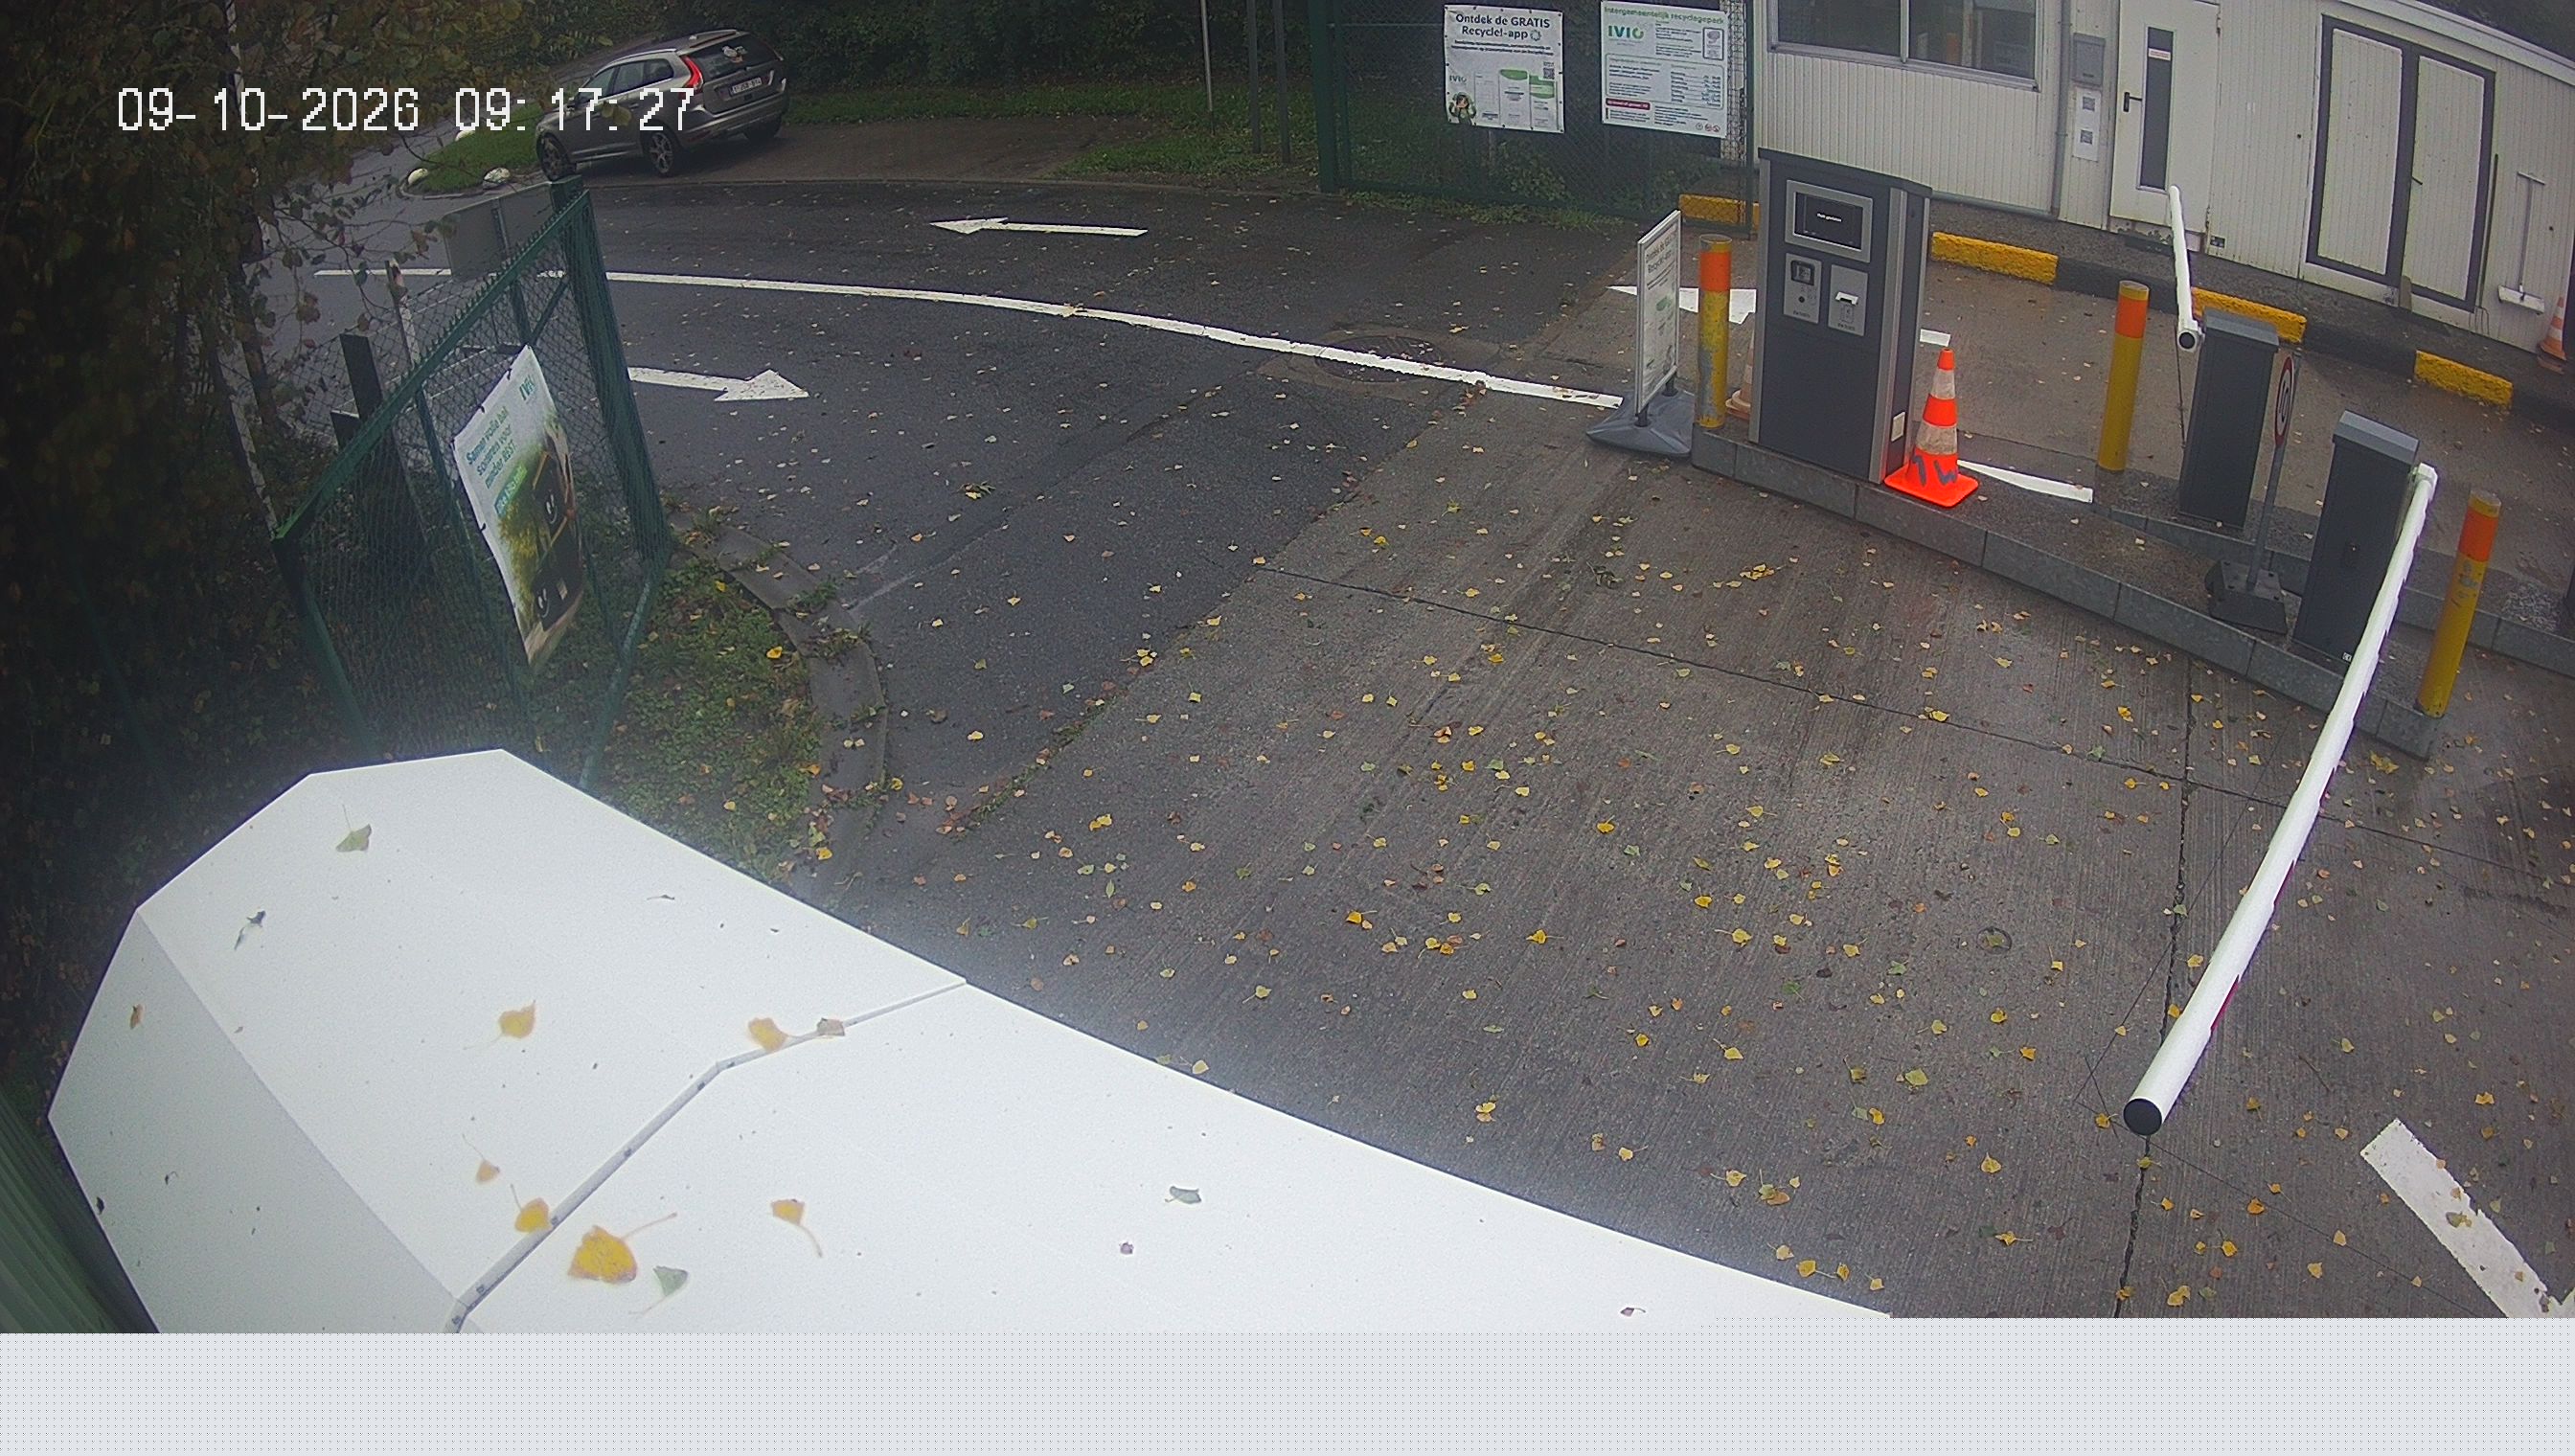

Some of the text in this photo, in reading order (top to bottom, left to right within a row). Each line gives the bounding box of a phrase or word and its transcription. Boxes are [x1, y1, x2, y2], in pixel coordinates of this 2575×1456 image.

[1455, 13, 1551, 28] Ontdek de GRATIS
[1607, 25, 1645, 39] IVIO
